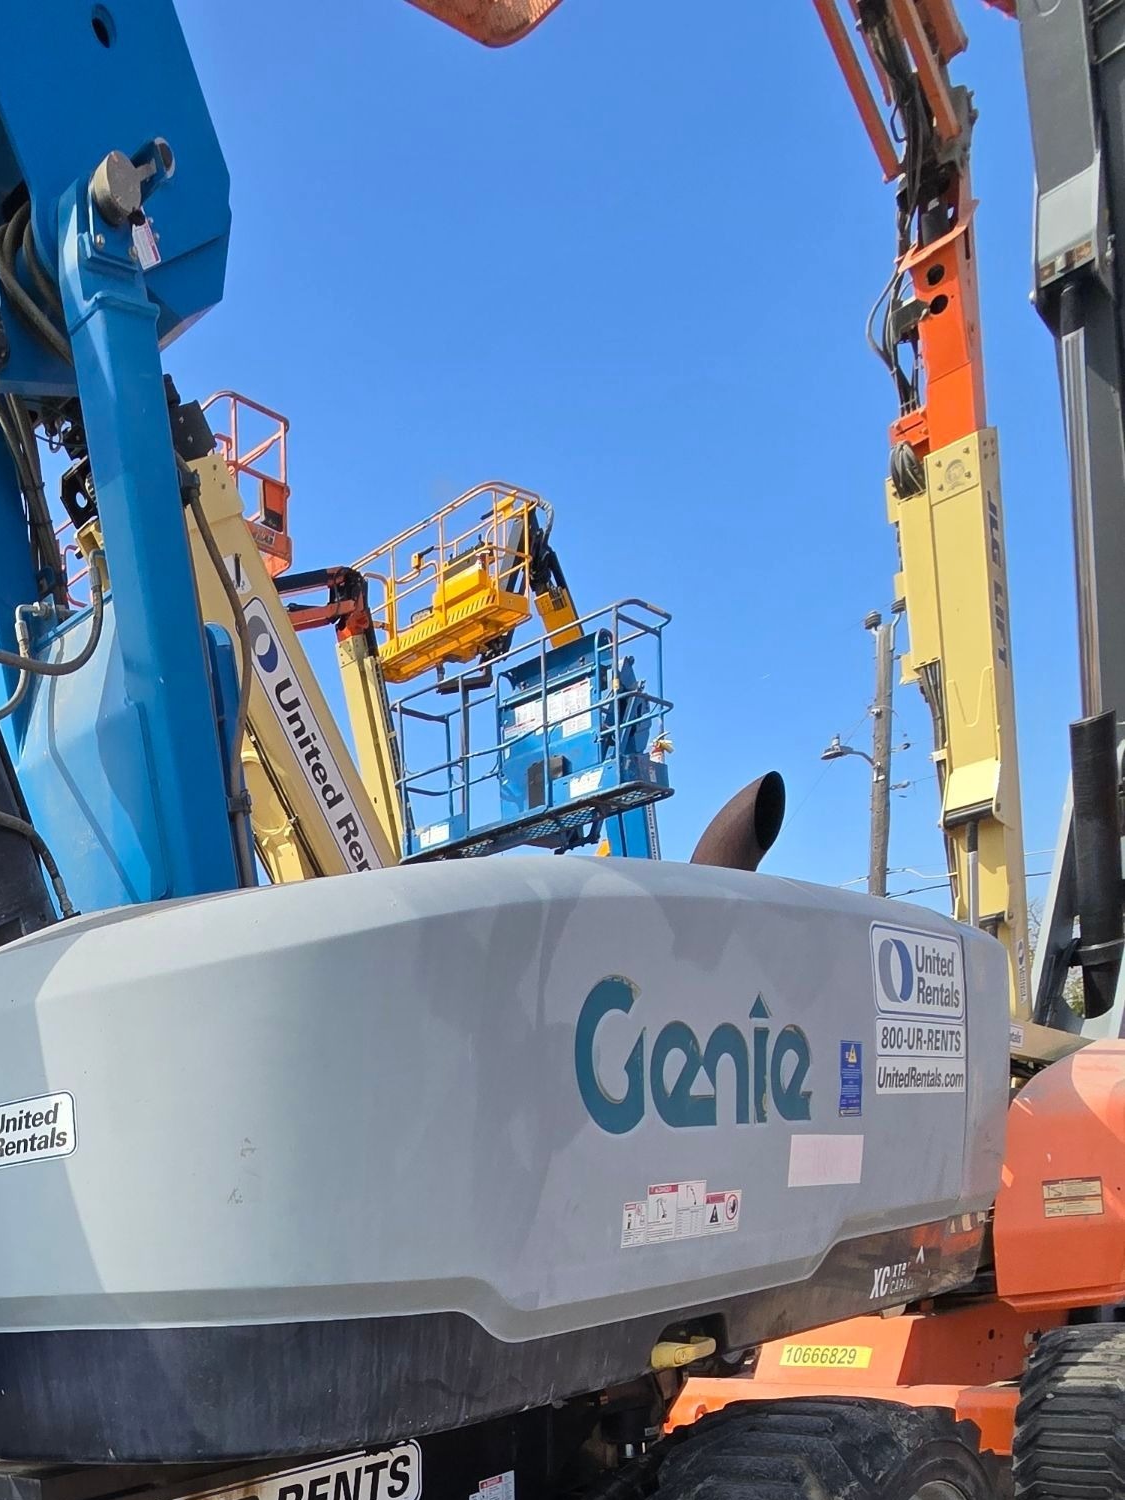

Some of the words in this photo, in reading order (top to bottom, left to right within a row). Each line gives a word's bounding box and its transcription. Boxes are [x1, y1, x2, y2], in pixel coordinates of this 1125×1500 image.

[274, 677, 345, 810] United
[915, 944, 955, 977] United
[916, 977, 960, 1009] Rentals
[575, 974, 813, 1135] Genie
[881, 1026, 961, 1052] 800-UR-RENTS
[877, 1066, 964, 1089] UnitedRentals.com
[869, 1266, 890, 1300] XC
[786, 1347, 857, 1365] 10666829
